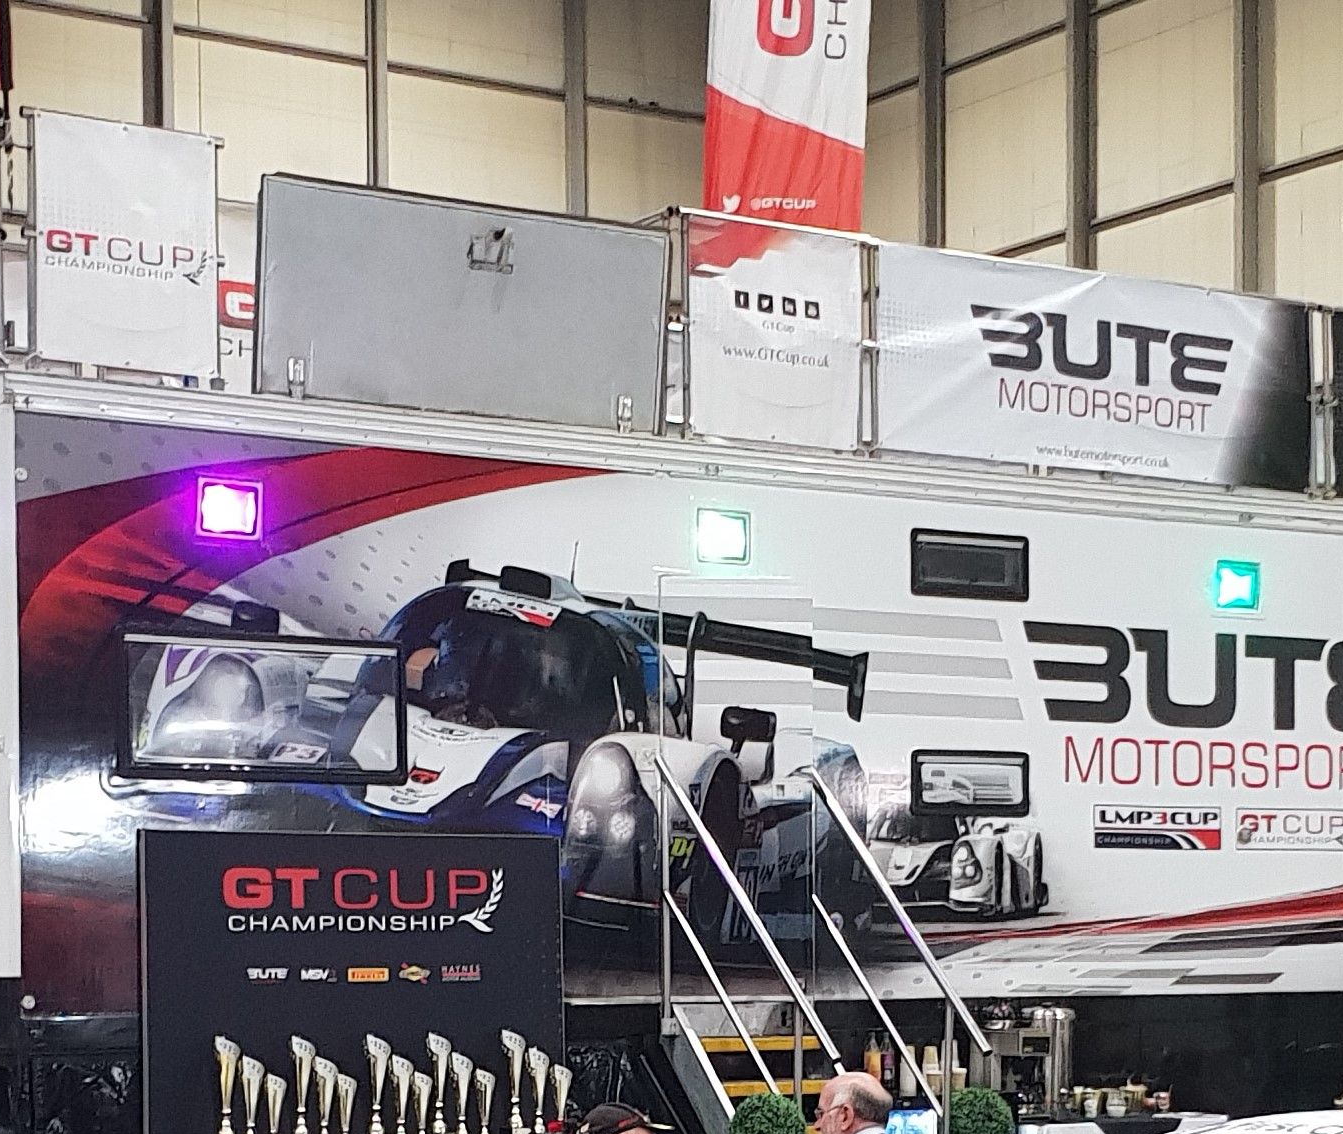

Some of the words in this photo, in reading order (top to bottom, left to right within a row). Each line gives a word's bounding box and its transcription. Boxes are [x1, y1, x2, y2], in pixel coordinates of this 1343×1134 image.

[46, 229, 99, 256] GT
[107, 237, 194, 268] CUP
[45, 254, 174, 281] CHAMPIONSHIP
[970, 303, 1234, 396] BUTE
[998, 377, 1212, 433] MOTORSPORT
[1099, 809, 1219, 826] LMP3CUP
[1244, 834, 1332, 846] HAMPIONSHIP
[222, 866, 320, 909] GT
[333, 867, 489, 910] CUP
[227, 914, 456, 932] CHAMPIONSHIP
